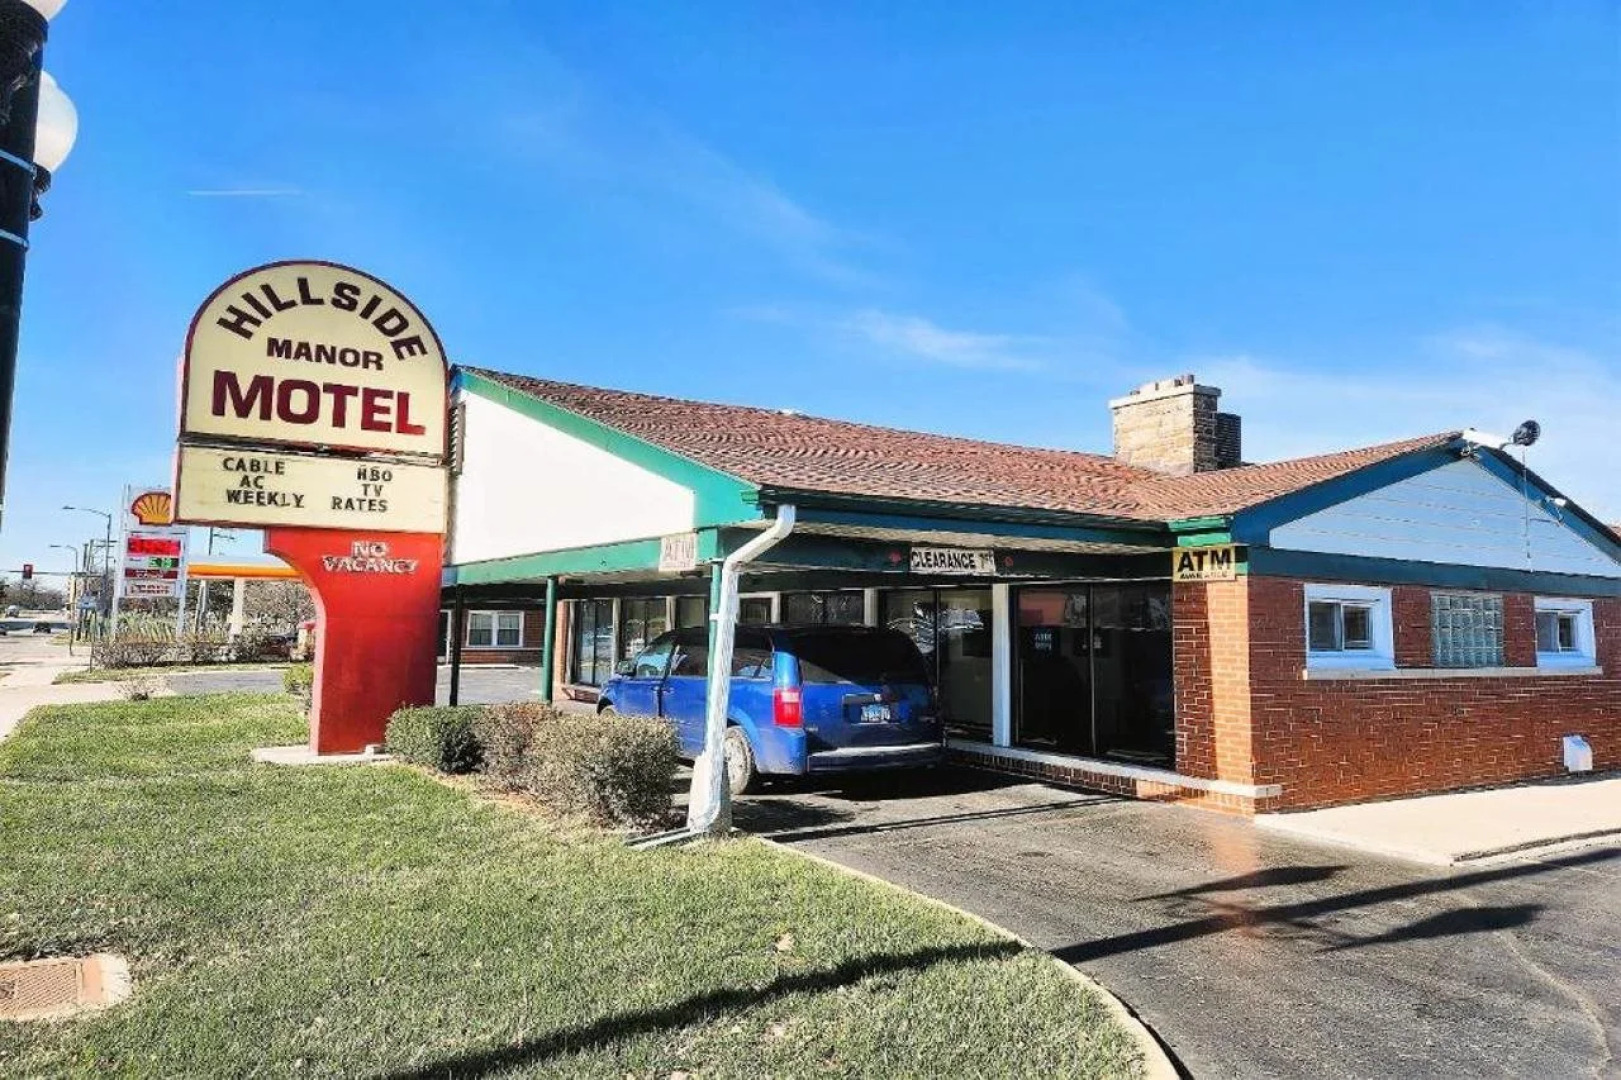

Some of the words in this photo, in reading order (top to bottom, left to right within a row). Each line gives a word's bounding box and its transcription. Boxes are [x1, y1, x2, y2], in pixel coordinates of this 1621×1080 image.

[216, 277, 428, 361] HILLSIDE
[266, 337, 384, 370] MANOR
[212, 370, 426, 435] MOTEL
[222, 457, 286, 475] CABLE
[357, 467, 393, 482] HBO
[239, 475, 264, 489] AC
[362, 483, 384, 497] TV
[226, 489, 305, 508] WEEKLY
[331, 496, 388, 513] RATES
[352, 541, 390, 557] NO
[911, 551, 976, 568] CLEARANCE
[1177, 547, 1231, 572] ATM
[322, 555, 418, 574] VACANCY
